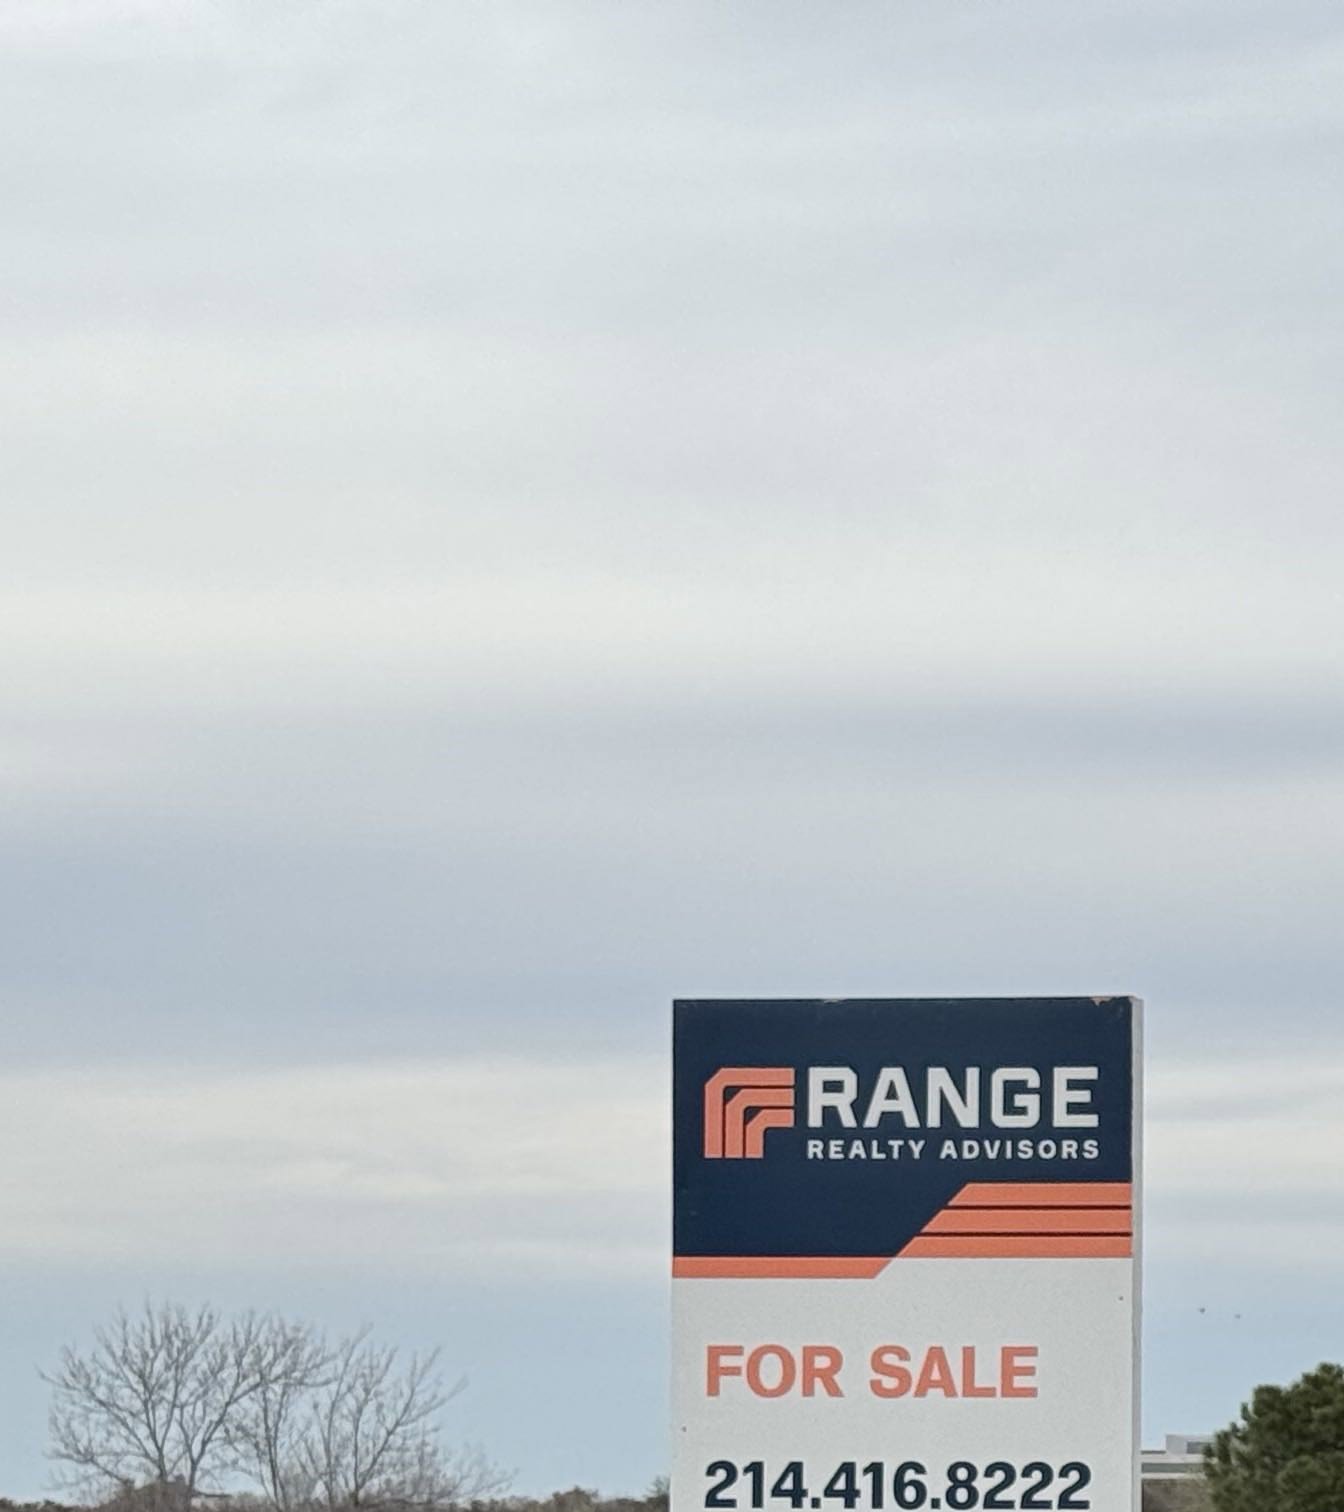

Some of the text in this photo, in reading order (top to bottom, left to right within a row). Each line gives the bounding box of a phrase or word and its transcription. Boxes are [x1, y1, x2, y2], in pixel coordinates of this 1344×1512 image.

[808, 1066, 1099, 1128] RANGE
[807, 1139, 1099, 1159] REALTY ADVISORS
[706, 1345, 1038, 1398] FOR SALE
[704, 1460, 1091, 1510] 214.416.8222
